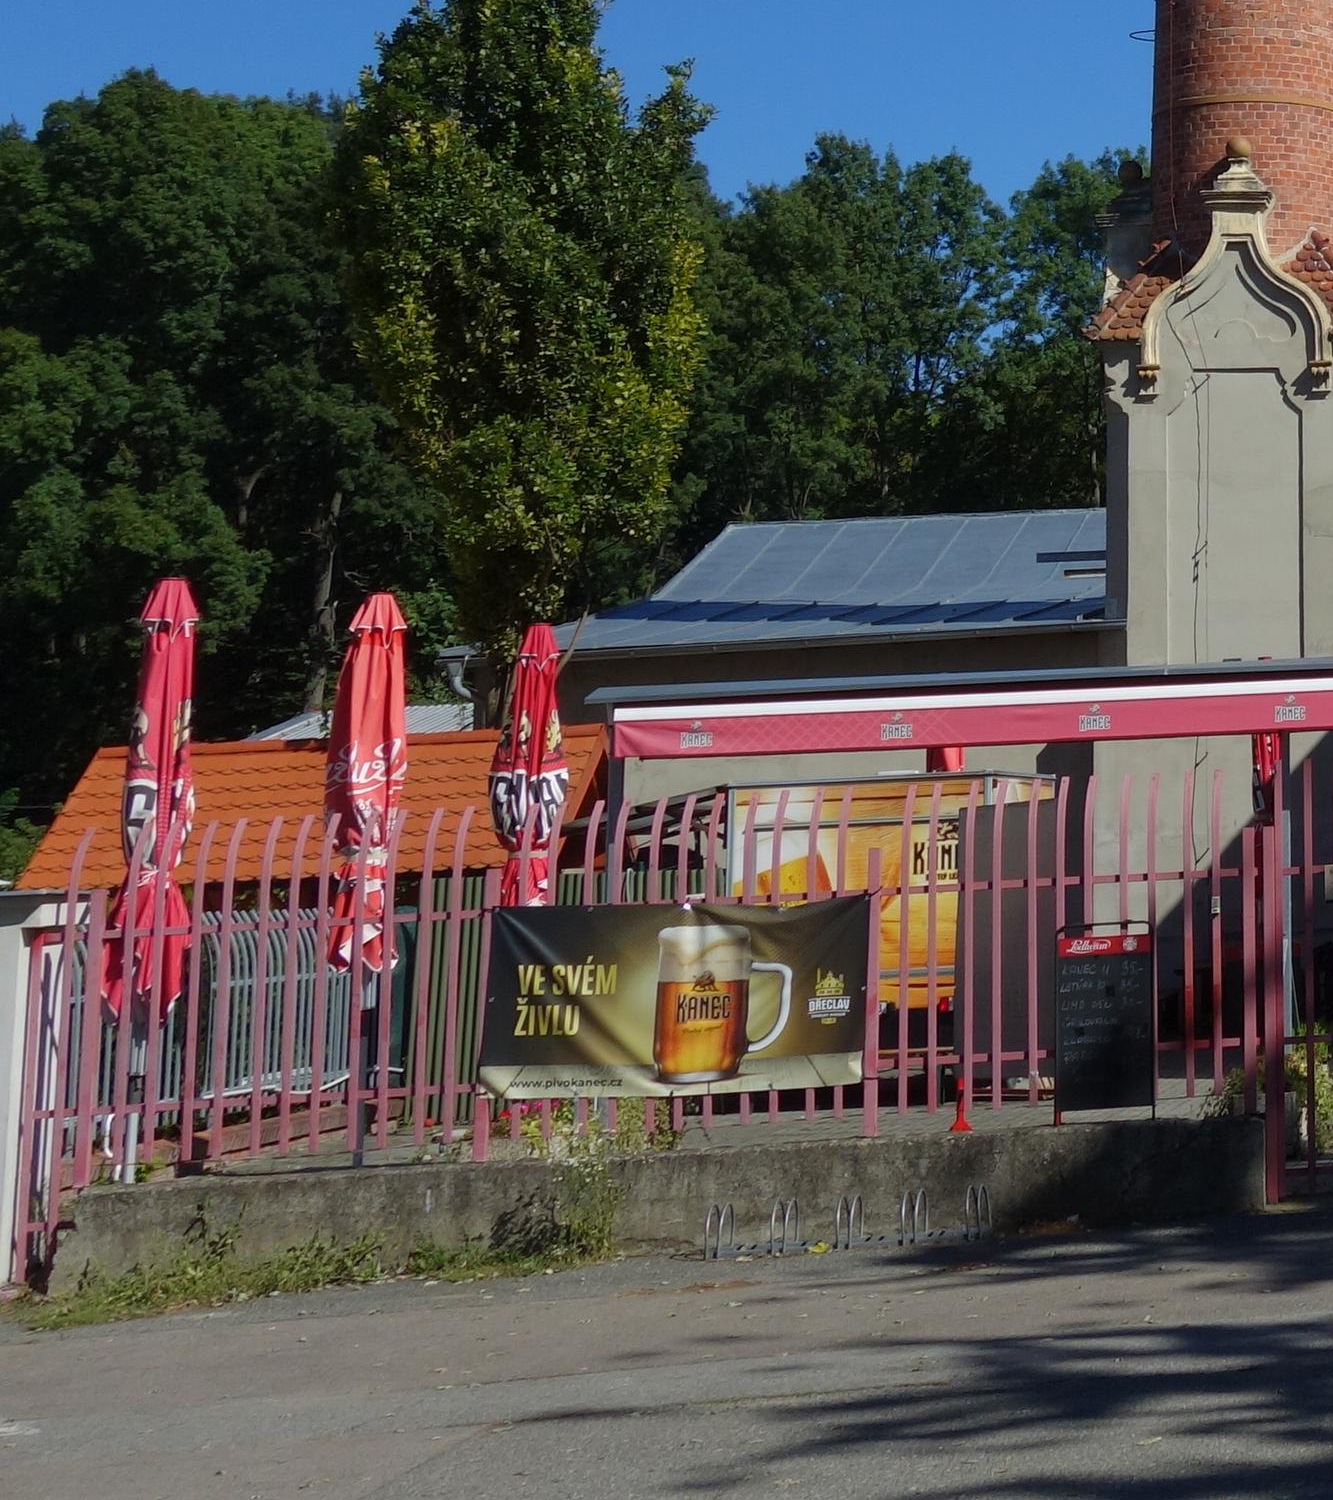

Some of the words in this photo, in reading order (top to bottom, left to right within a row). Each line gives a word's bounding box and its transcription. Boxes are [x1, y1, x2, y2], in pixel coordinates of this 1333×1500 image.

[1274, 706, 1306, 723] KANEC
[881, 723, 913, 740] KANEC
[1079, 715, 1111, 732] KANEC
[680, 732, 713, 749] KANEC
[518, 964, 546, 996] VE
[552, 955, 618, 996] SVÉM
[676, 994, 732, 1023] KANEC
[513, 998, 580, 1037] ŽIVLU
[510, 1077, 623, 1090] www.pivokanec.cz
